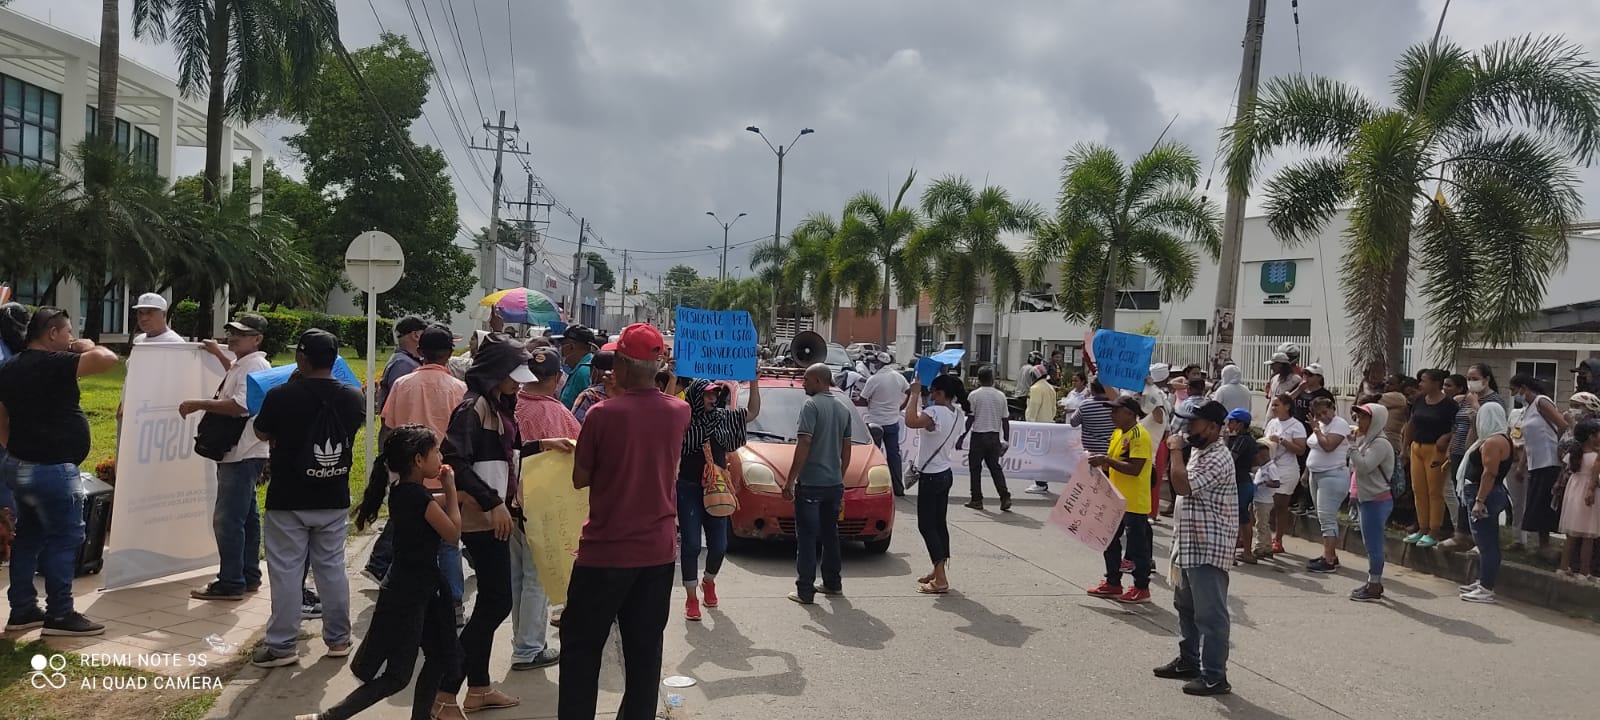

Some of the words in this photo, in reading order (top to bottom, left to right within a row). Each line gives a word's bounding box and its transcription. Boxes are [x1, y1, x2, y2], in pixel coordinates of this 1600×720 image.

[679, 308, 724, 326] PRESIDENTE
[677, 340, 697, 361] HP
[306, 466, 348, 478] adidas
